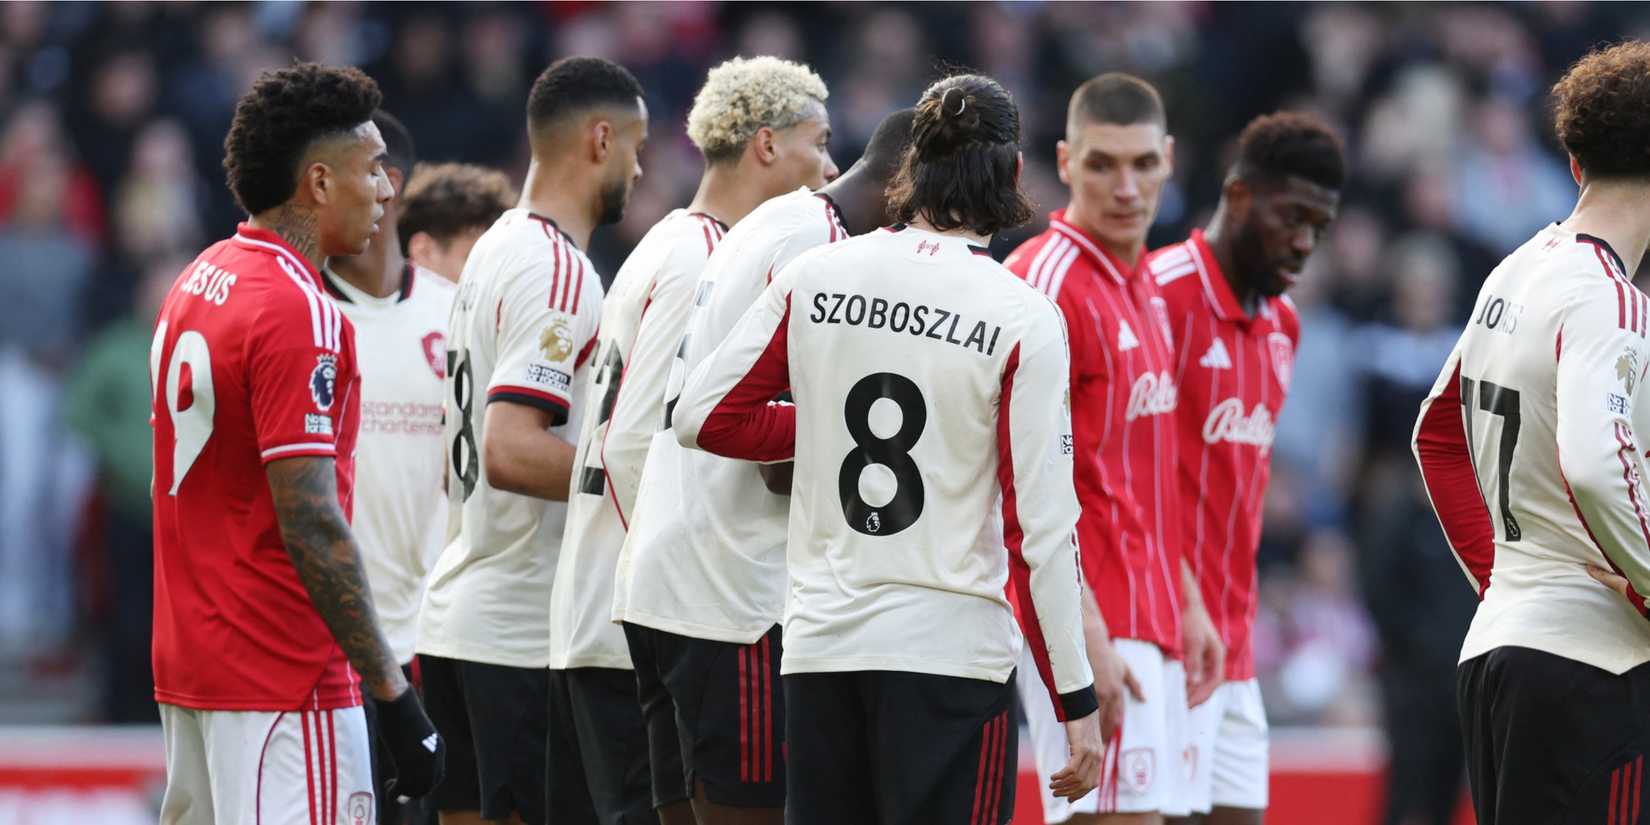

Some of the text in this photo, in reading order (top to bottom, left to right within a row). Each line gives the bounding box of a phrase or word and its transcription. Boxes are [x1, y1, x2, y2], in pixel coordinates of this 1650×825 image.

[809, 292, 1002, 357] SZOBOSZLAI
[447, 348, 480, 503] 8
[838, 372, 928, 537] 8
